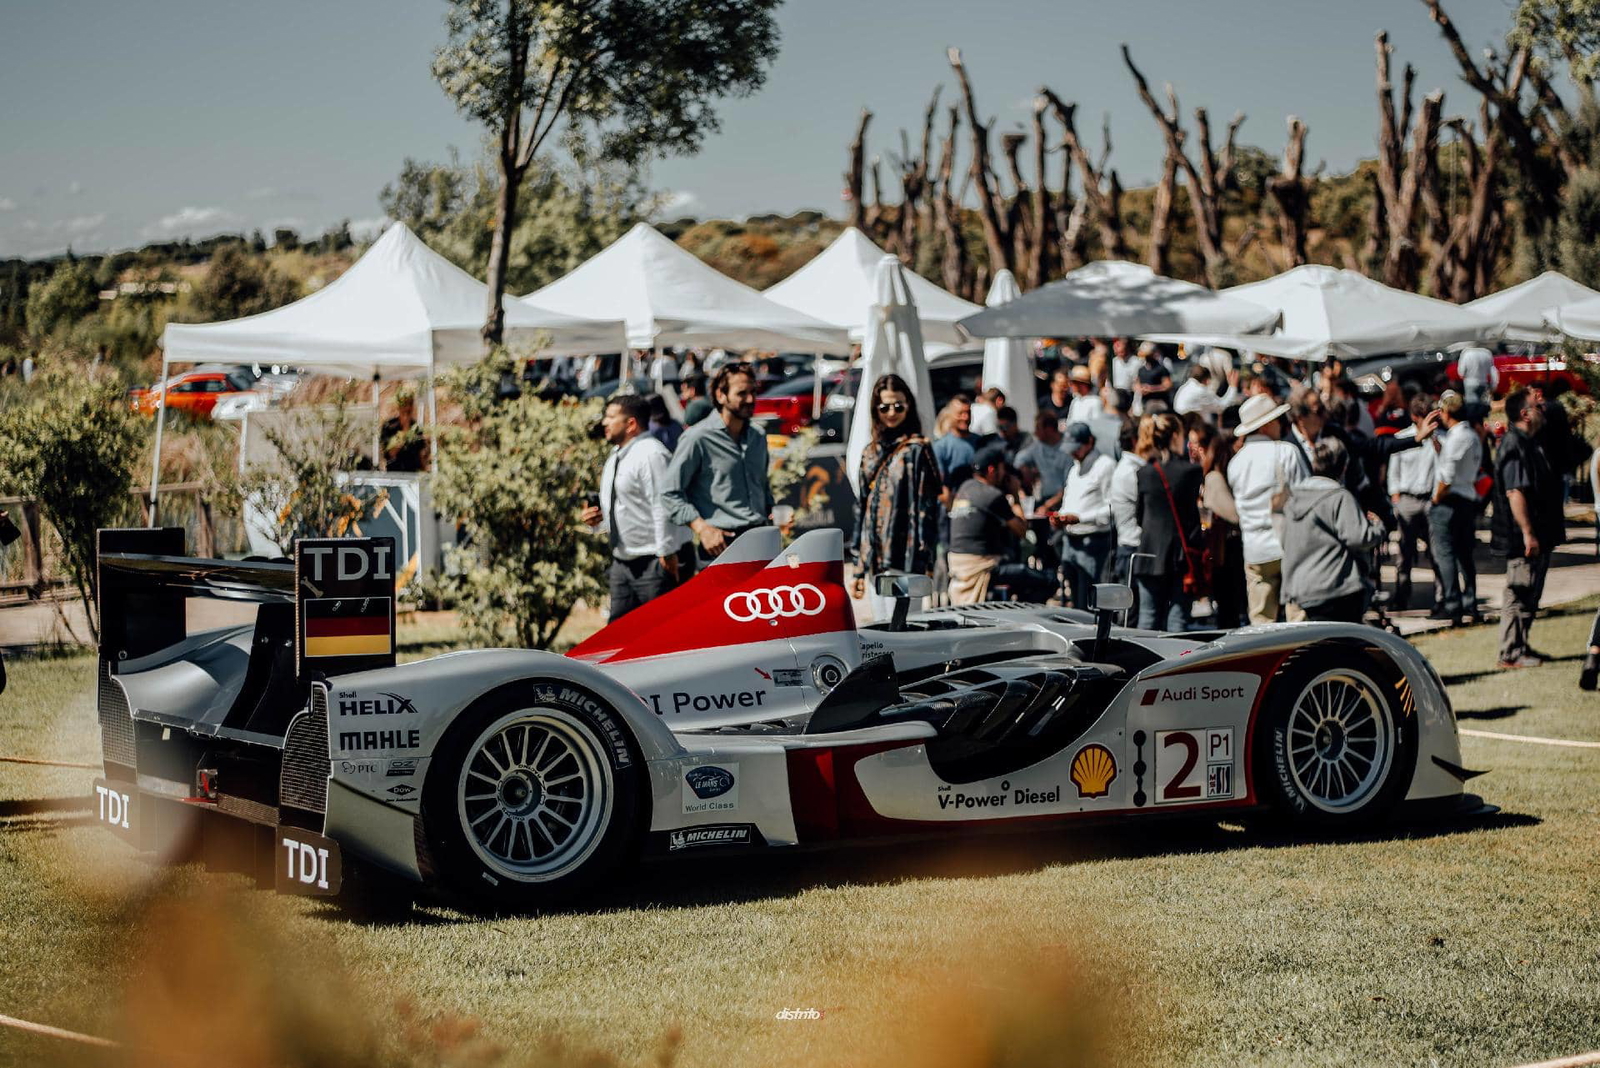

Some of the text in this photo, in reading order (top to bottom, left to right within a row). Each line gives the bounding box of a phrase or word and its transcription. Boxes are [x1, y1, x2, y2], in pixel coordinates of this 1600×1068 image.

[303, 546, 391, 581] TDI
[860, 641, 884, 651] apello
[674, 690, 767, 714] Power
[1162, 686, 1244, 701] Audi Sport
[339, 699, 418, 716] HELIX
[560, 688, 629, 763] MICHELIN
[340, 730, 420, 751] MAHLE
[358, 765, 377, 773] PTC
[1163, 732, 1229, 800] 2 P1
[1274, 731, 1296, 798] MICHELIN
[96, 786, 129, 829] TDI
[685, 802, 735, 812] World Class
[938, 785, 1060, 809] V-Power Diesel
[687, 829, 748, 842] MICHELIN
[283, 838, 329, 889] TDI
